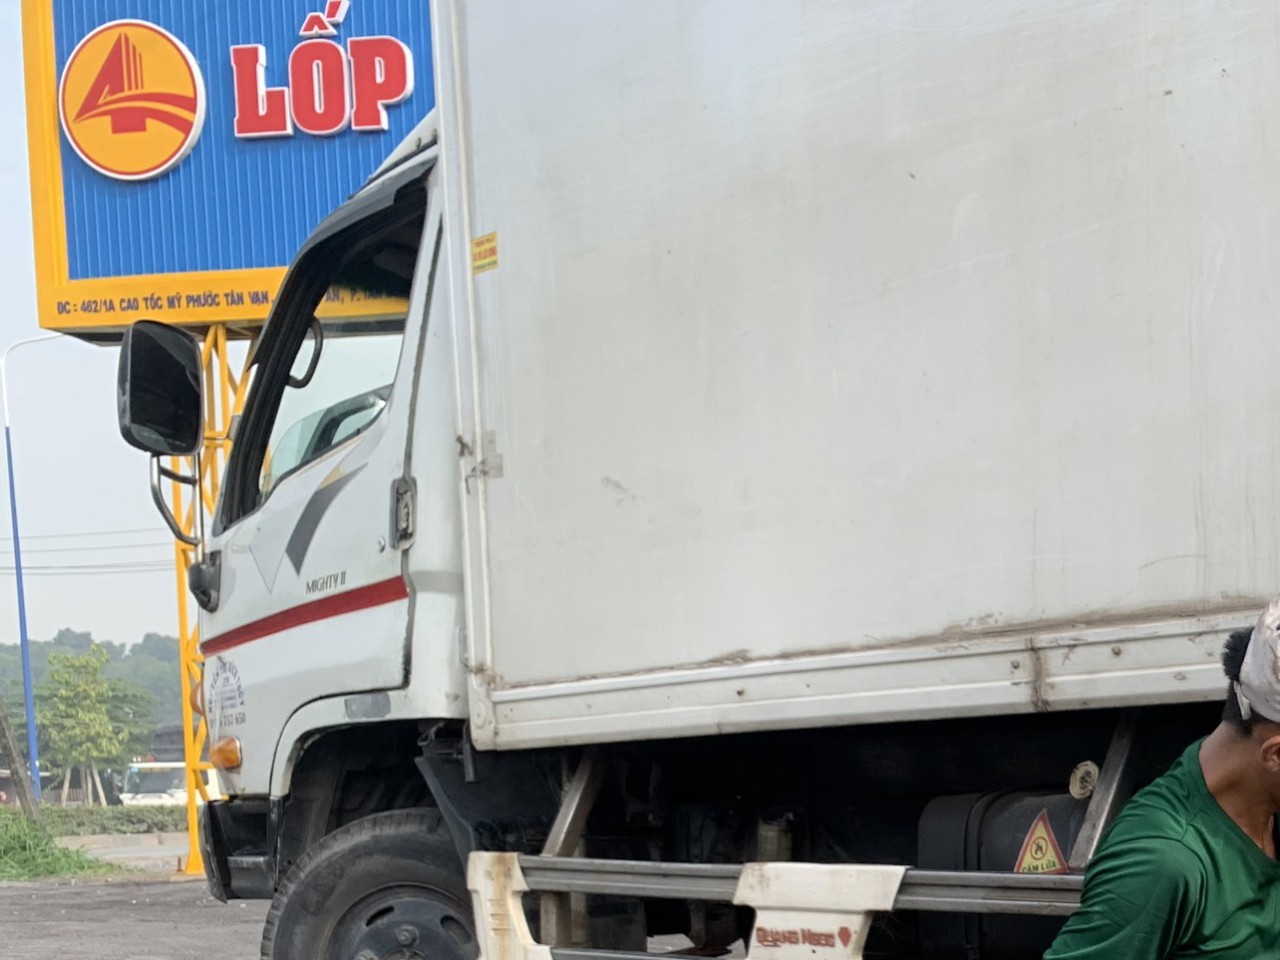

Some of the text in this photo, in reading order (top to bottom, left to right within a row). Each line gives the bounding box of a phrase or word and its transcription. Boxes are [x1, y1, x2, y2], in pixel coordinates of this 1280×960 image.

[230, 0, 414, 137] LỐP
[119, 297, 139, 311] CAO
[144, 292, 163, 310] TỐC
[224, 289, 244, 306] TÂN
[305, 573, 339, 595] MIGHTY
